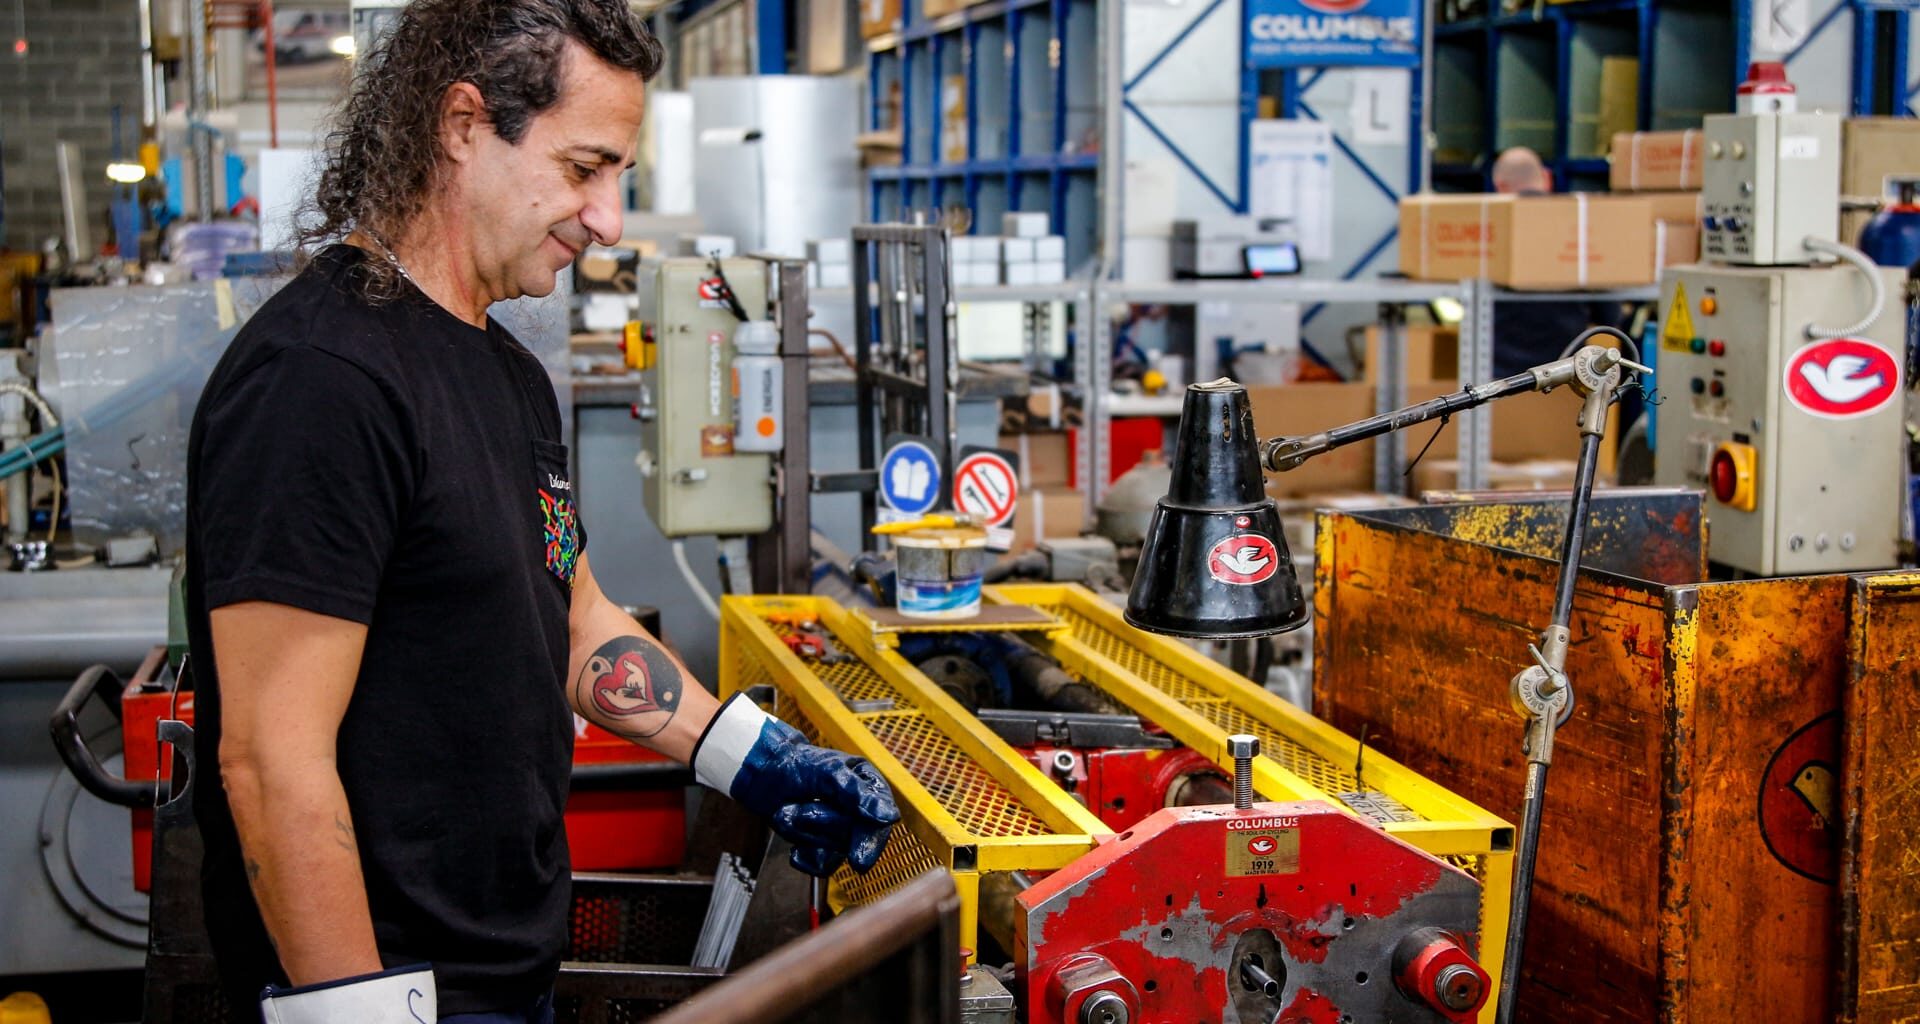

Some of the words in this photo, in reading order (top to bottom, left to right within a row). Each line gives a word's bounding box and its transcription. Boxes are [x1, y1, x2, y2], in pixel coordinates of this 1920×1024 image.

[1251, 14, 1414, 40] COLUMBUS
[1370, 90, 1389, 131] L
[1226, 817, 1299, 829] COLUMBUS
[1251, 860, 1274, 870] 1919
